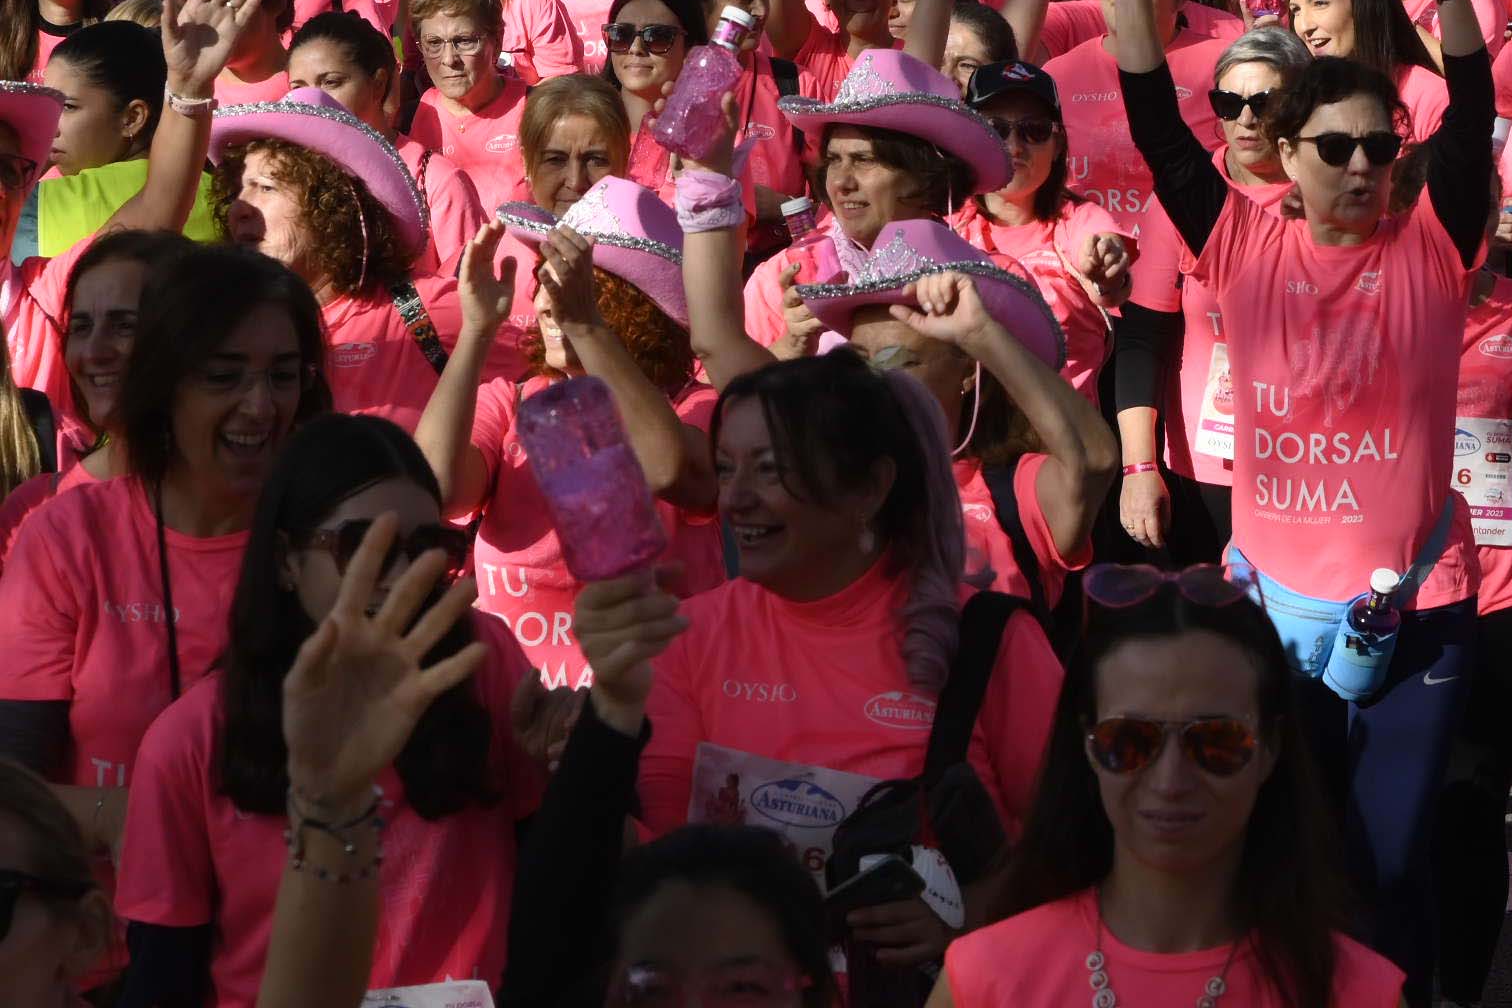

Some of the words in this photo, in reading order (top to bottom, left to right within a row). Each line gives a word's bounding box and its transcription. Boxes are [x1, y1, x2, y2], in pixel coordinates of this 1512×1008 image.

[1072, 91, 1118, 103] OYSHO
[1253, 380, 1289, 417] TU
[1208, 438, 1233, 450] OYS
[1255, 428, 1399, 464] DORSAL
[1456, 441, 1476, 451] IANA
[1486, 436, 1512, 444] SUMA
[1457, 468, 1472, 485] 6
[1256, 474, 1360, 512] SUMA
[1341, 514, 1364, 524] 2023
[1486, 509, 1503, 517] 2023
[1473, 527, 1507, 537] ntander
[483, 563, 528, 597] TU
[540, 659, 594, 692] MA
[753, 790, 838, 823] ASTURIANA
